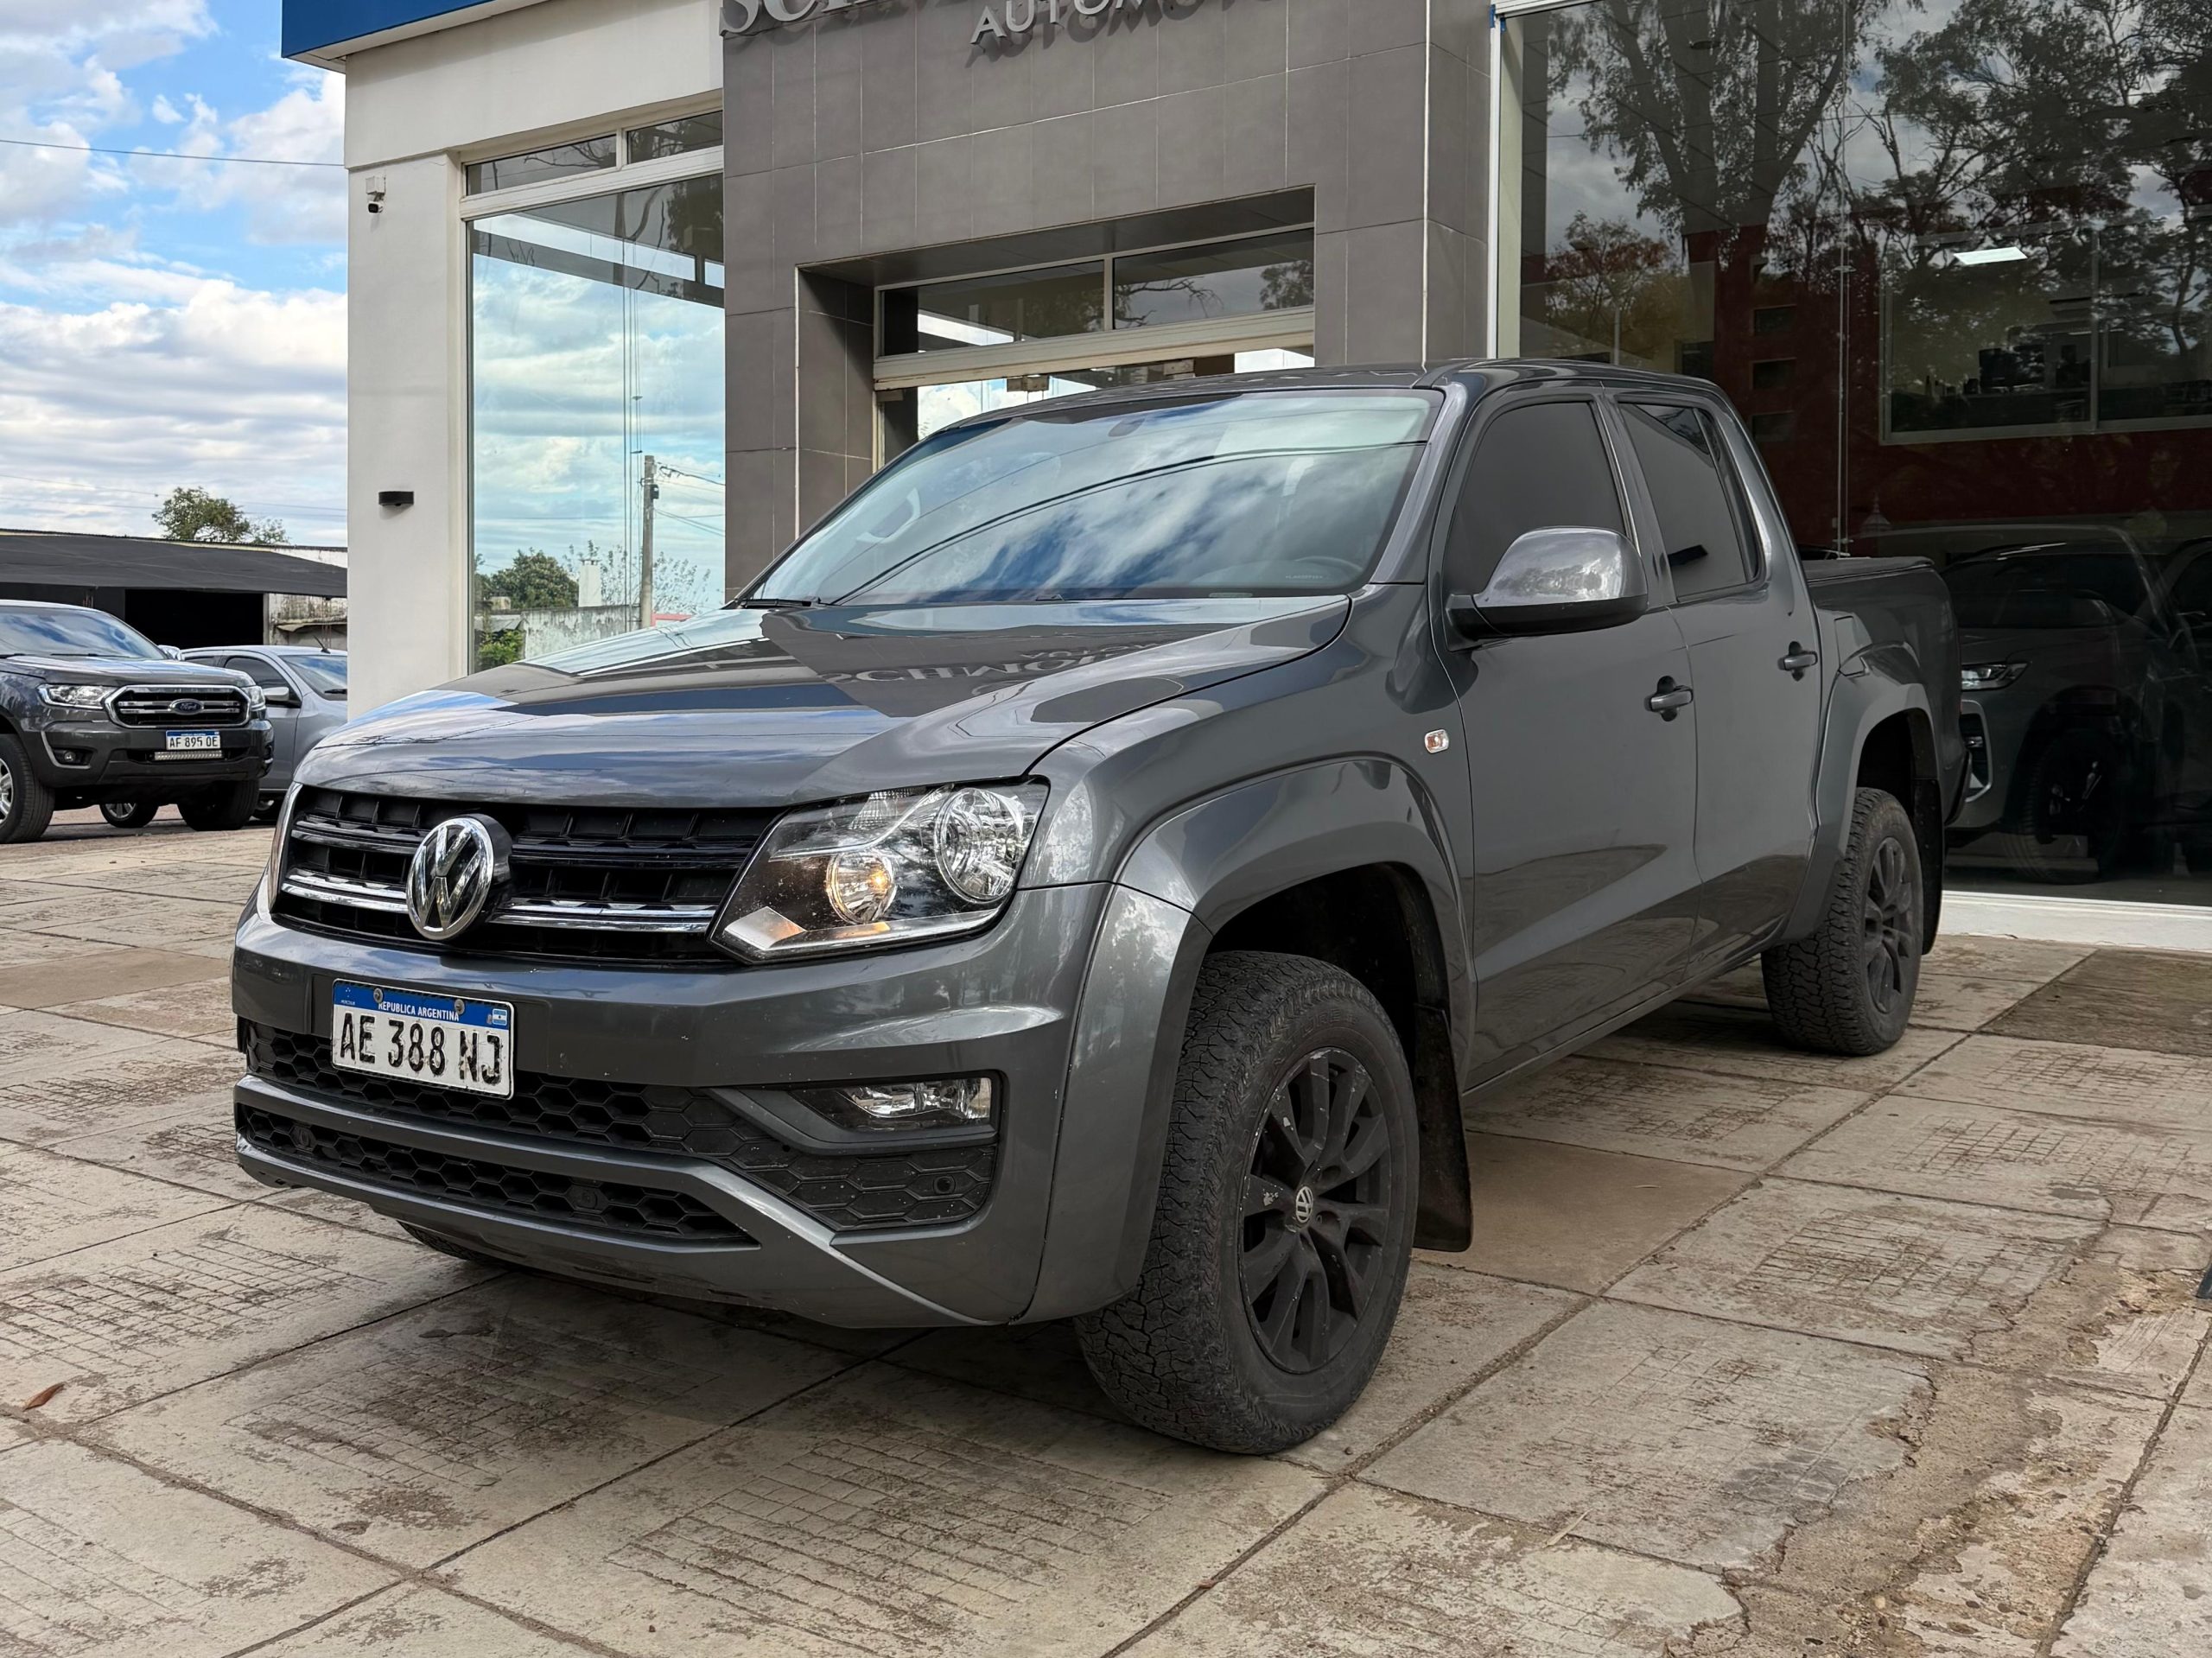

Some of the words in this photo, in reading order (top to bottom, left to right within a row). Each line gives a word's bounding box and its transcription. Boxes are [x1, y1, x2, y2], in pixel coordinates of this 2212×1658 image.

[169, 737, 181, 748] AF
[409, 821, 490, 935] VW
[378, 1001, 416, 1015] REPUBLICA
[417, 1007, 460, 1022] ARGENTINA
[340, 1013, 375, 1064] AE
[388, 1020, 446, 1076] 388
[459, 1029, 502, 1085] NJ
